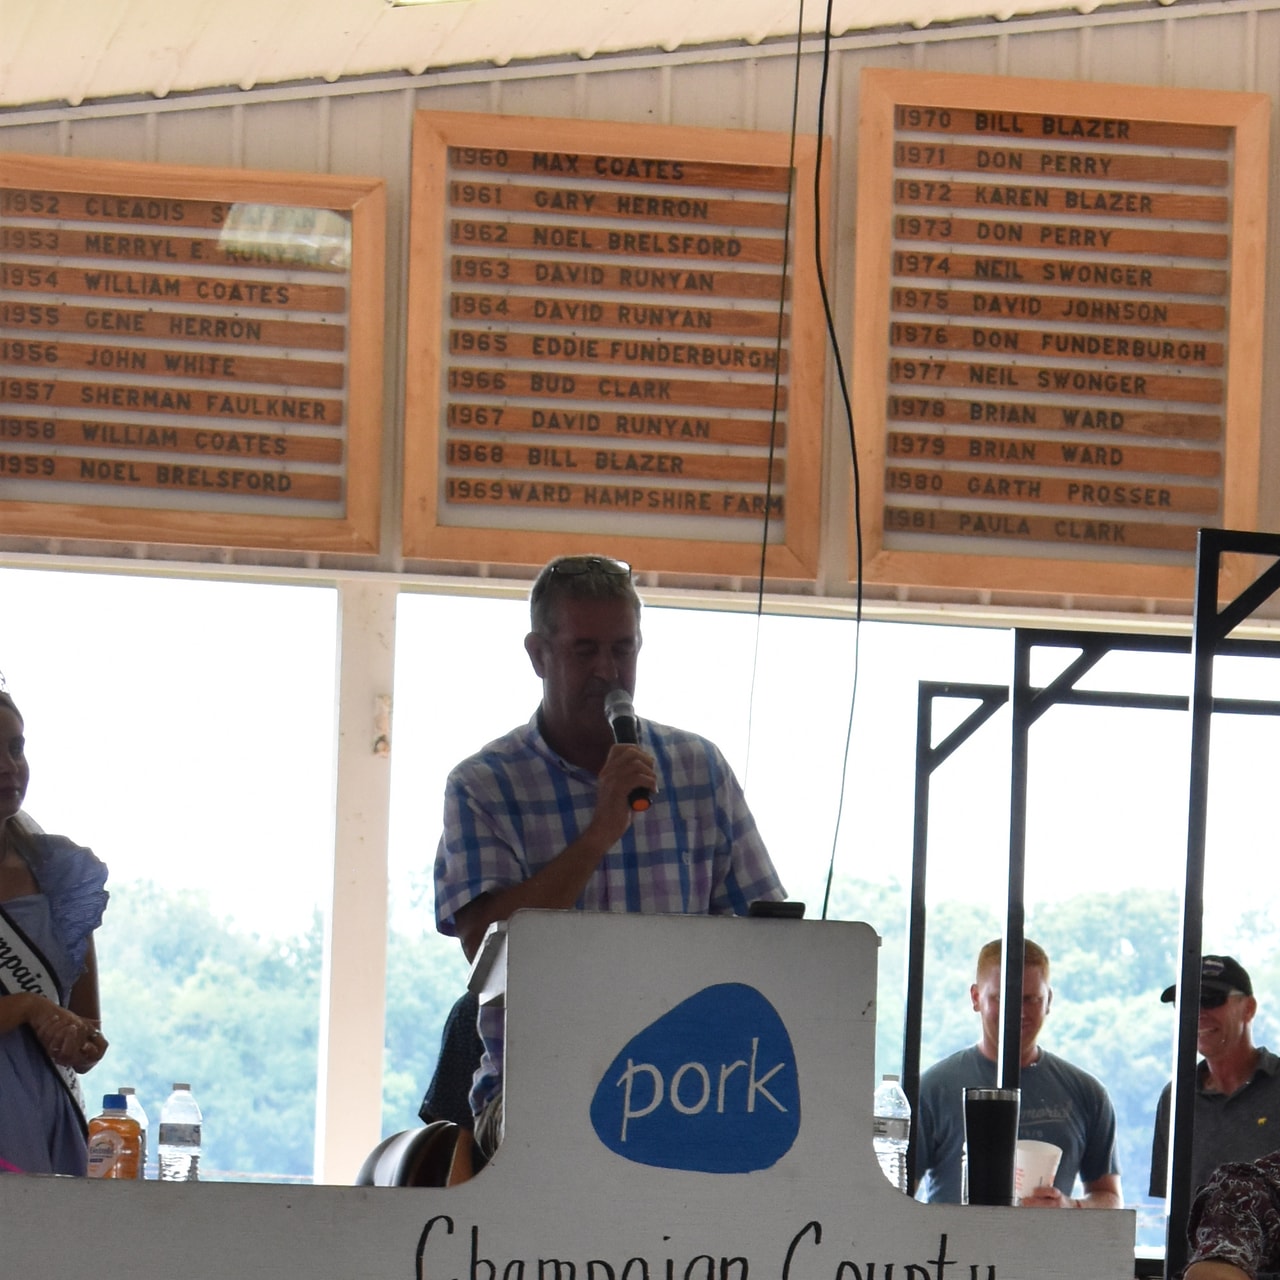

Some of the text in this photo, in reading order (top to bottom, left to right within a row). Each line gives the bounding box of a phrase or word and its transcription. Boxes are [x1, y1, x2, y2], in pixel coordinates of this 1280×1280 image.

[899, 110, 1130, 139] 1970 BILL BLAZER
[453, 186, 708, 219] 1961 GARY HERRON
[898, 183, 1152, 213] 1972 KAREN BLAZER
[452, 224, 741, 256] 1962 NOEL BRELSFORD
[2, 269, 289, 303] 1954 WILLIAM COATES
[898, 255, 1152, 286] 1974 NEIL SWONGER
[2, 343, 235, 376] 1956 JOHN WHITE
[452, 333, 777, 369] 1965 EDDIE FUNDERBURGH
[895, 328, 1206, 360] 1976 DON FUNDERBURGH
[893, 364, 1146, 394] 1977 NEIL SWONGER
[0, 382, 325, 420] 1957 SHERMAN FAULKNER
[0, 420, 287, 454] 1958 WILLIAM COATES
[0, 456, 292, 492] 1959 NOEL BRELSFORD
[449, 444, 684, 473] 1968 BILL BLAZER
[584, 491, 711, 511] HAMPSHIRE
[616, 1036, 788, 1142] pork
